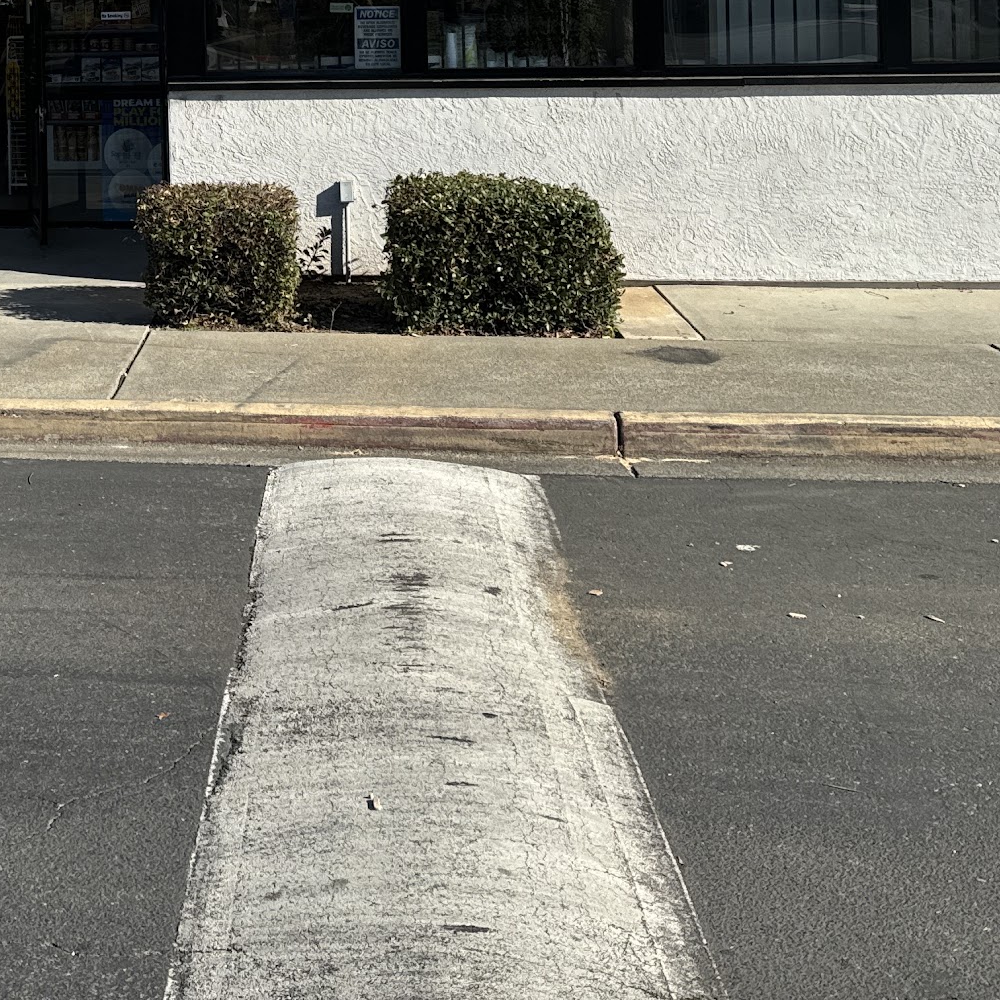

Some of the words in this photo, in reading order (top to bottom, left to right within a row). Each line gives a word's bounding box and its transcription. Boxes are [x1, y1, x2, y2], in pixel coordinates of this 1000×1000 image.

[359, 9, 397, 19] NOTICE
[361, 39, 396, 49] AVISO
[113, 98, 153, 107] DREAM
[113, 107, 145, 116] PLAY
